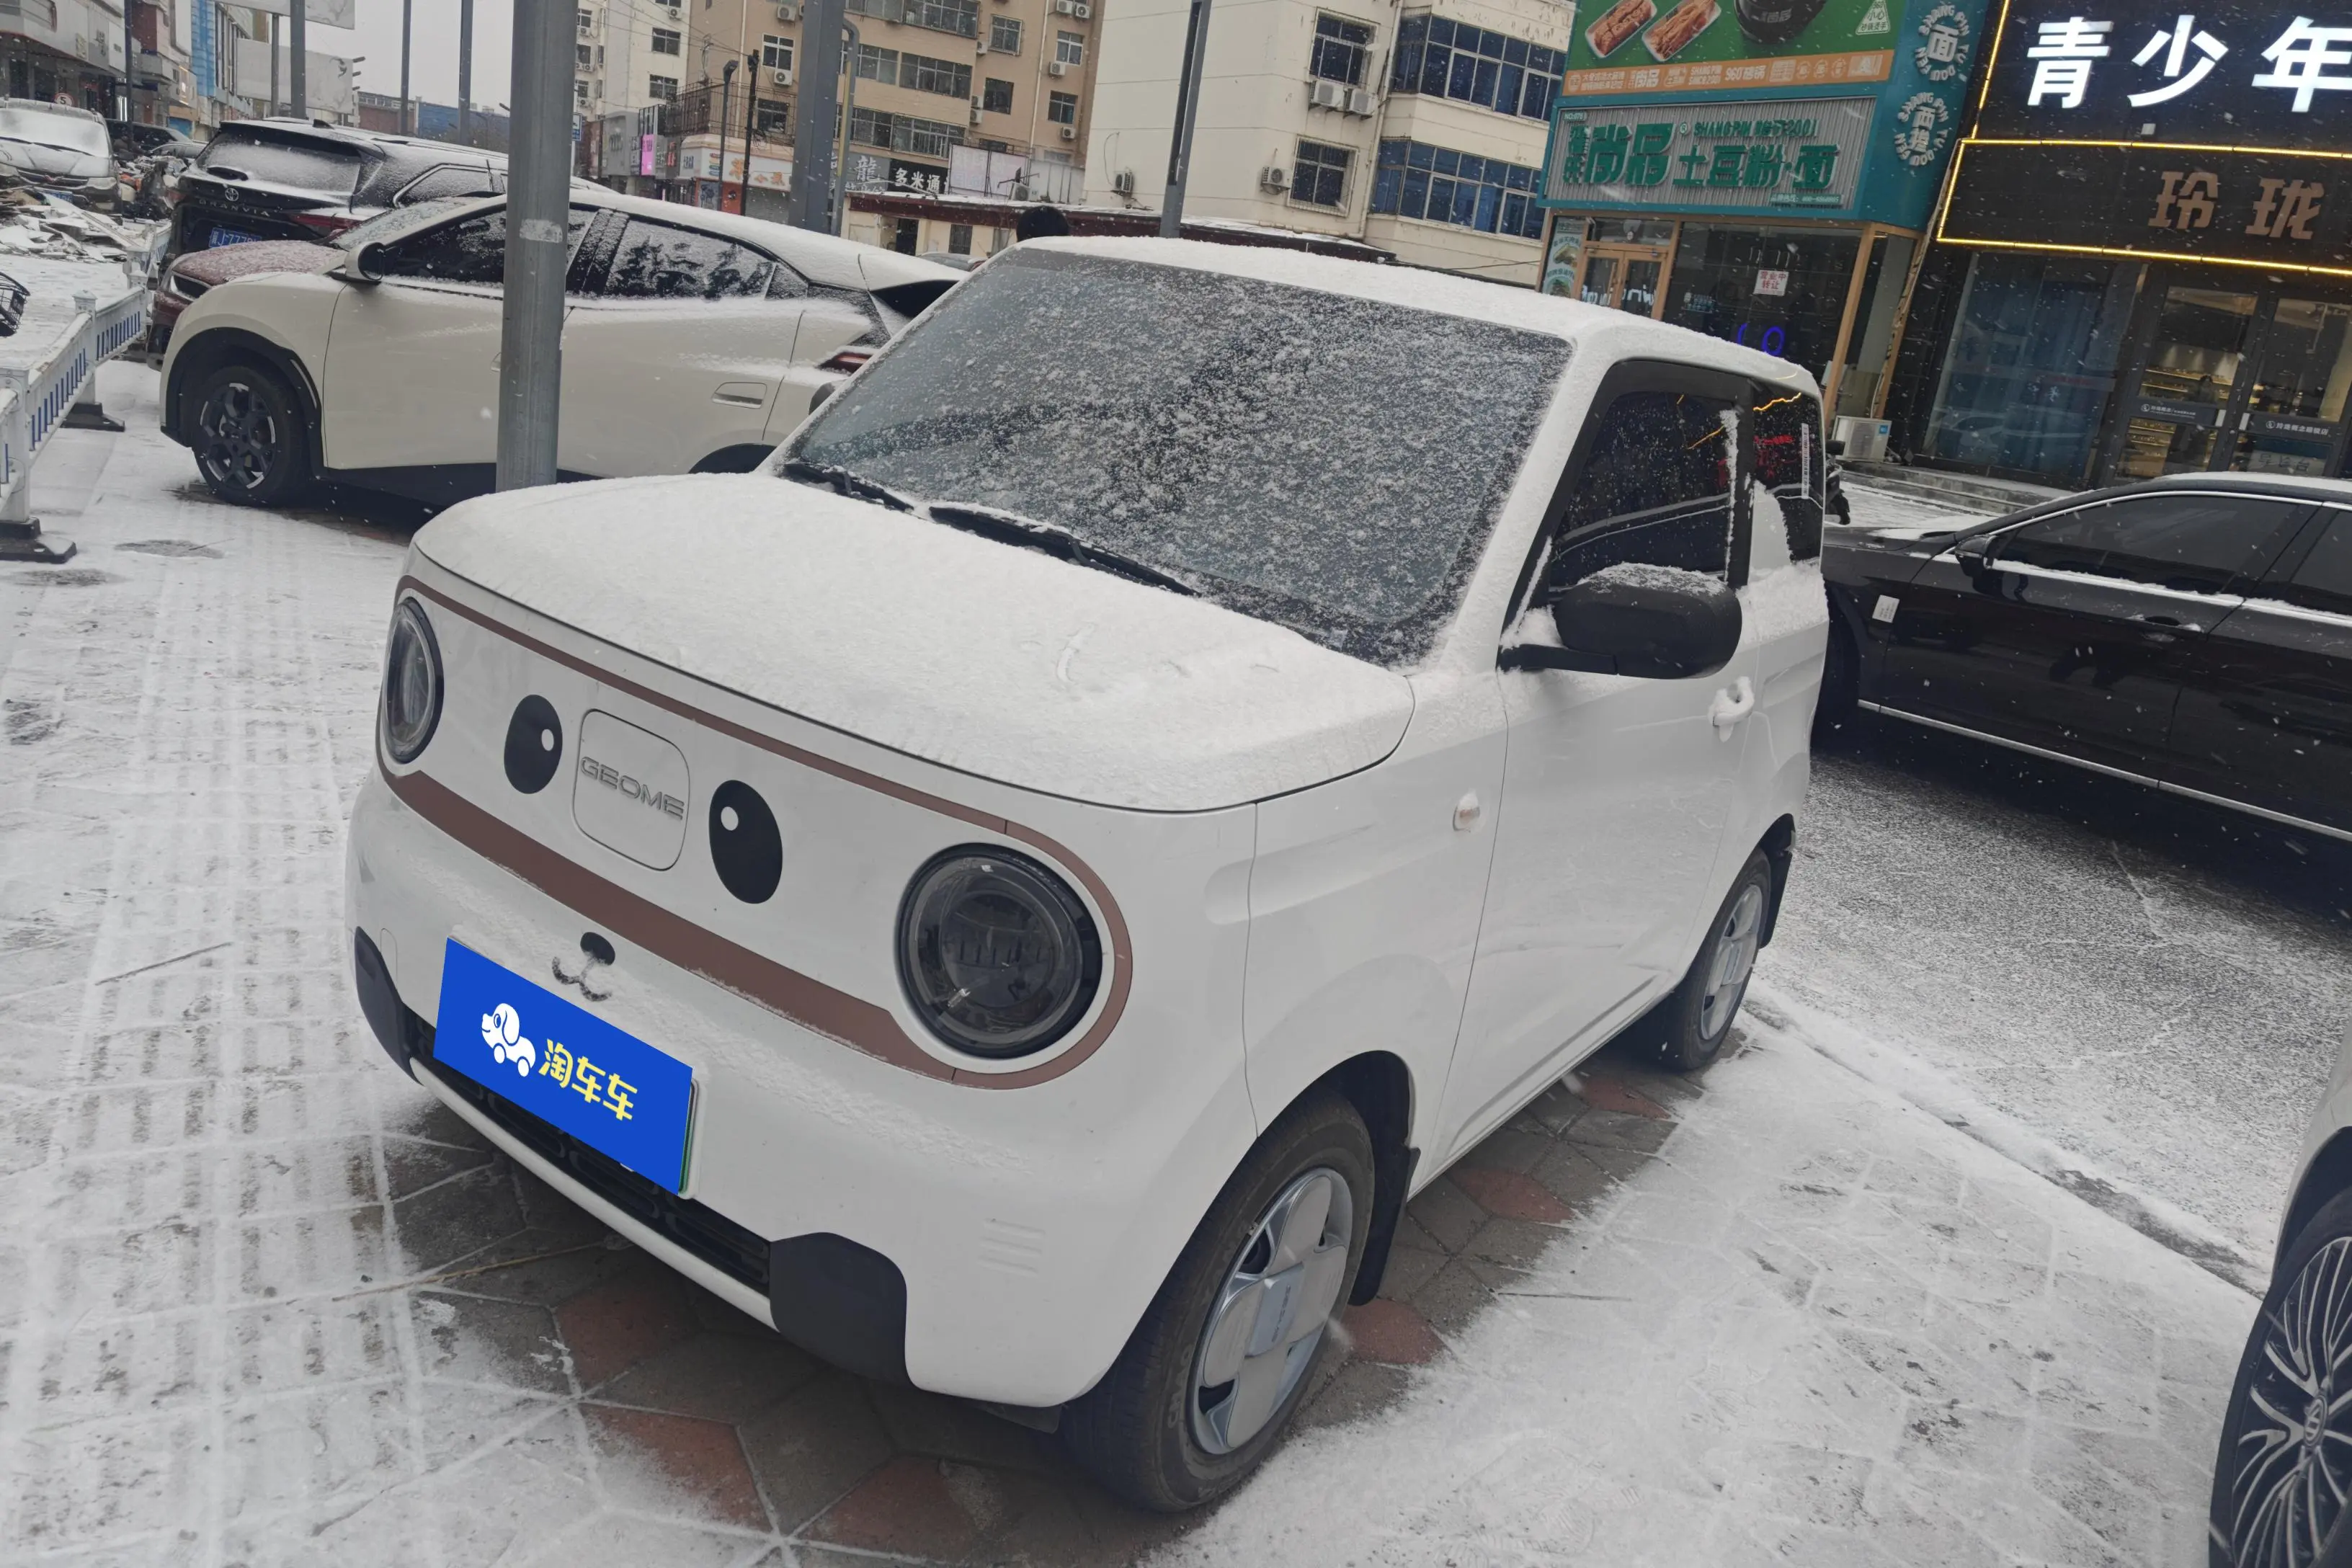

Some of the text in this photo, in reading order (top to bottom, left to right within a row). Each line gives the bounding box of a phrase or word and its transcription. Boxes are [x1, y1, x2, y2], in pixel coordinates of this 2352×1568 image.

[1867, 11, 1885, 21] 小心
[1928, 23, 1960, 63] 面
[2027, 14, 2352, 112] 青少年
[59, 96, 66, 104] 5
[1584, 124, 1673, 186] 尚品
[198, 199, 270, 217] GRANVIA
[2148, 171, 2325, 240] 玲珑
[1760, 271, 1787, 281] 营业中
[1762, 280, 1780, 290] 转让
[581, 756, 685, 821] GEOME
